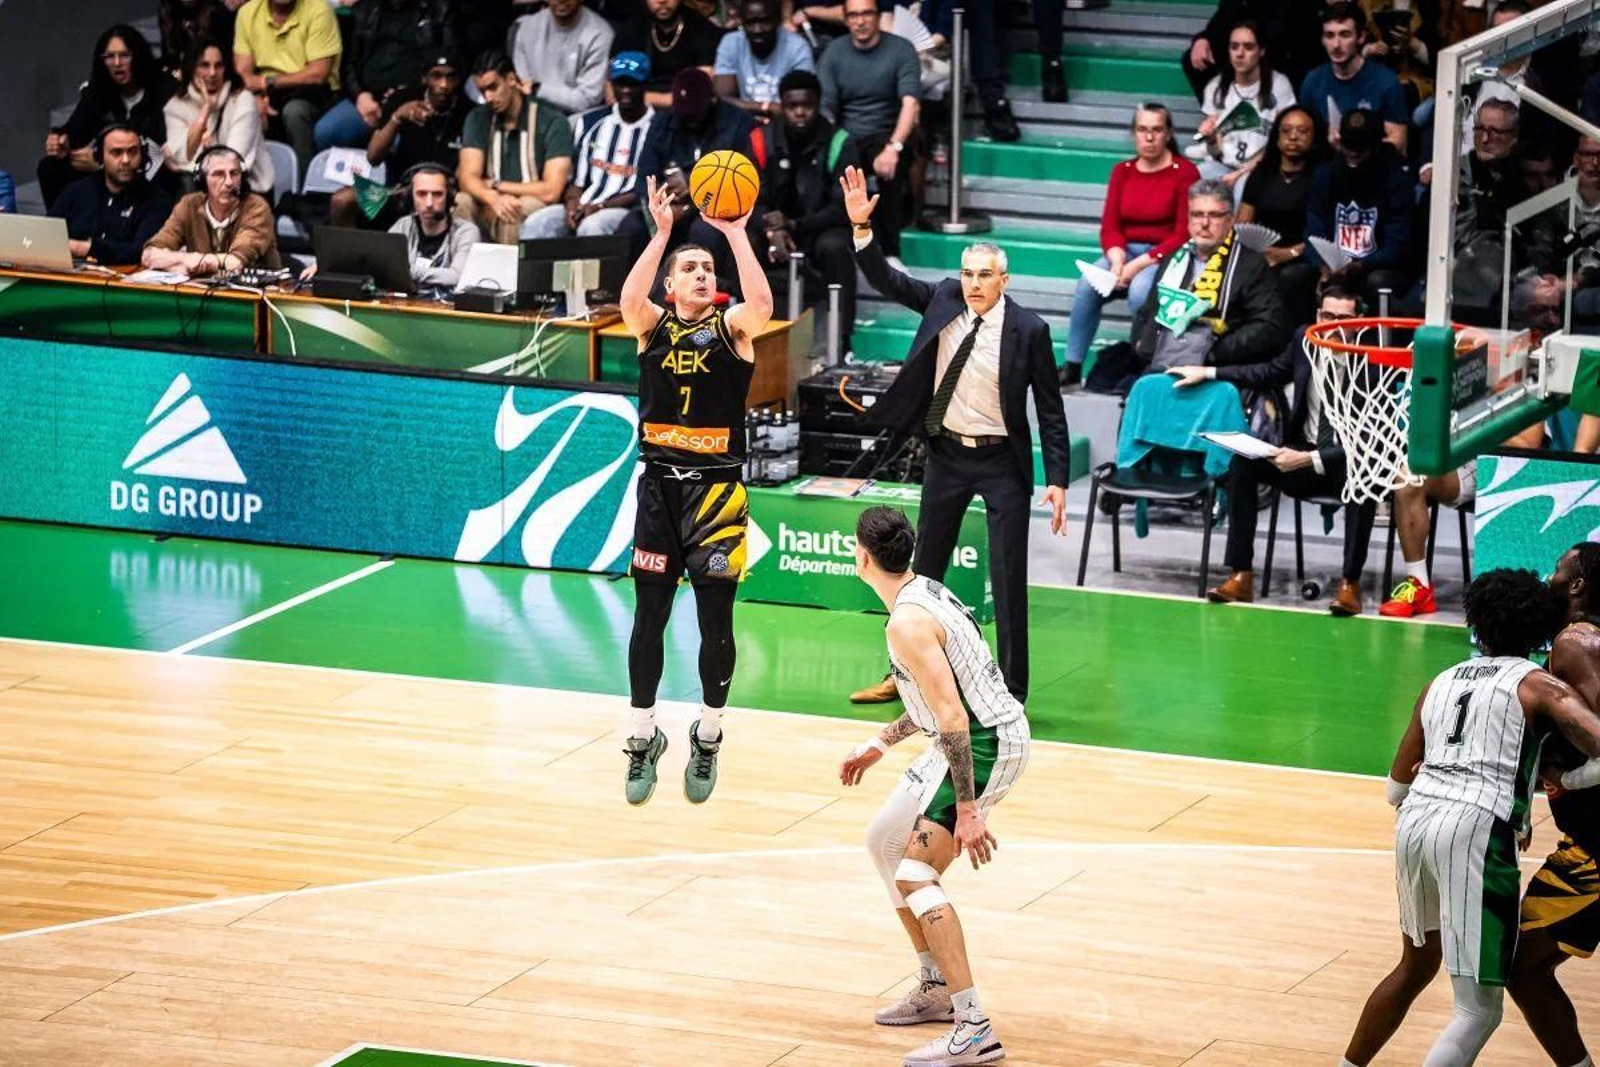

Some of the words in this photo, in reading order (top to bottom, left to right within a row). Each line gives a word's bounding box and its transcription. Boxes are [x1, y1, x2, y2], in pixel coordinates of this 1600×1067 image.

[1341, 225, 1371, 250] NFL
[661, 349, 711, 373] AEK
[680, 386, 691, 415] 7
[110, 480, 149, 513] DG
[158, 485, 263, 524] GROUP
[779, 522, 857, 557] hauts
[779, 554, 857, 576] Départem
[1444, 689, 1474, 747] 1
